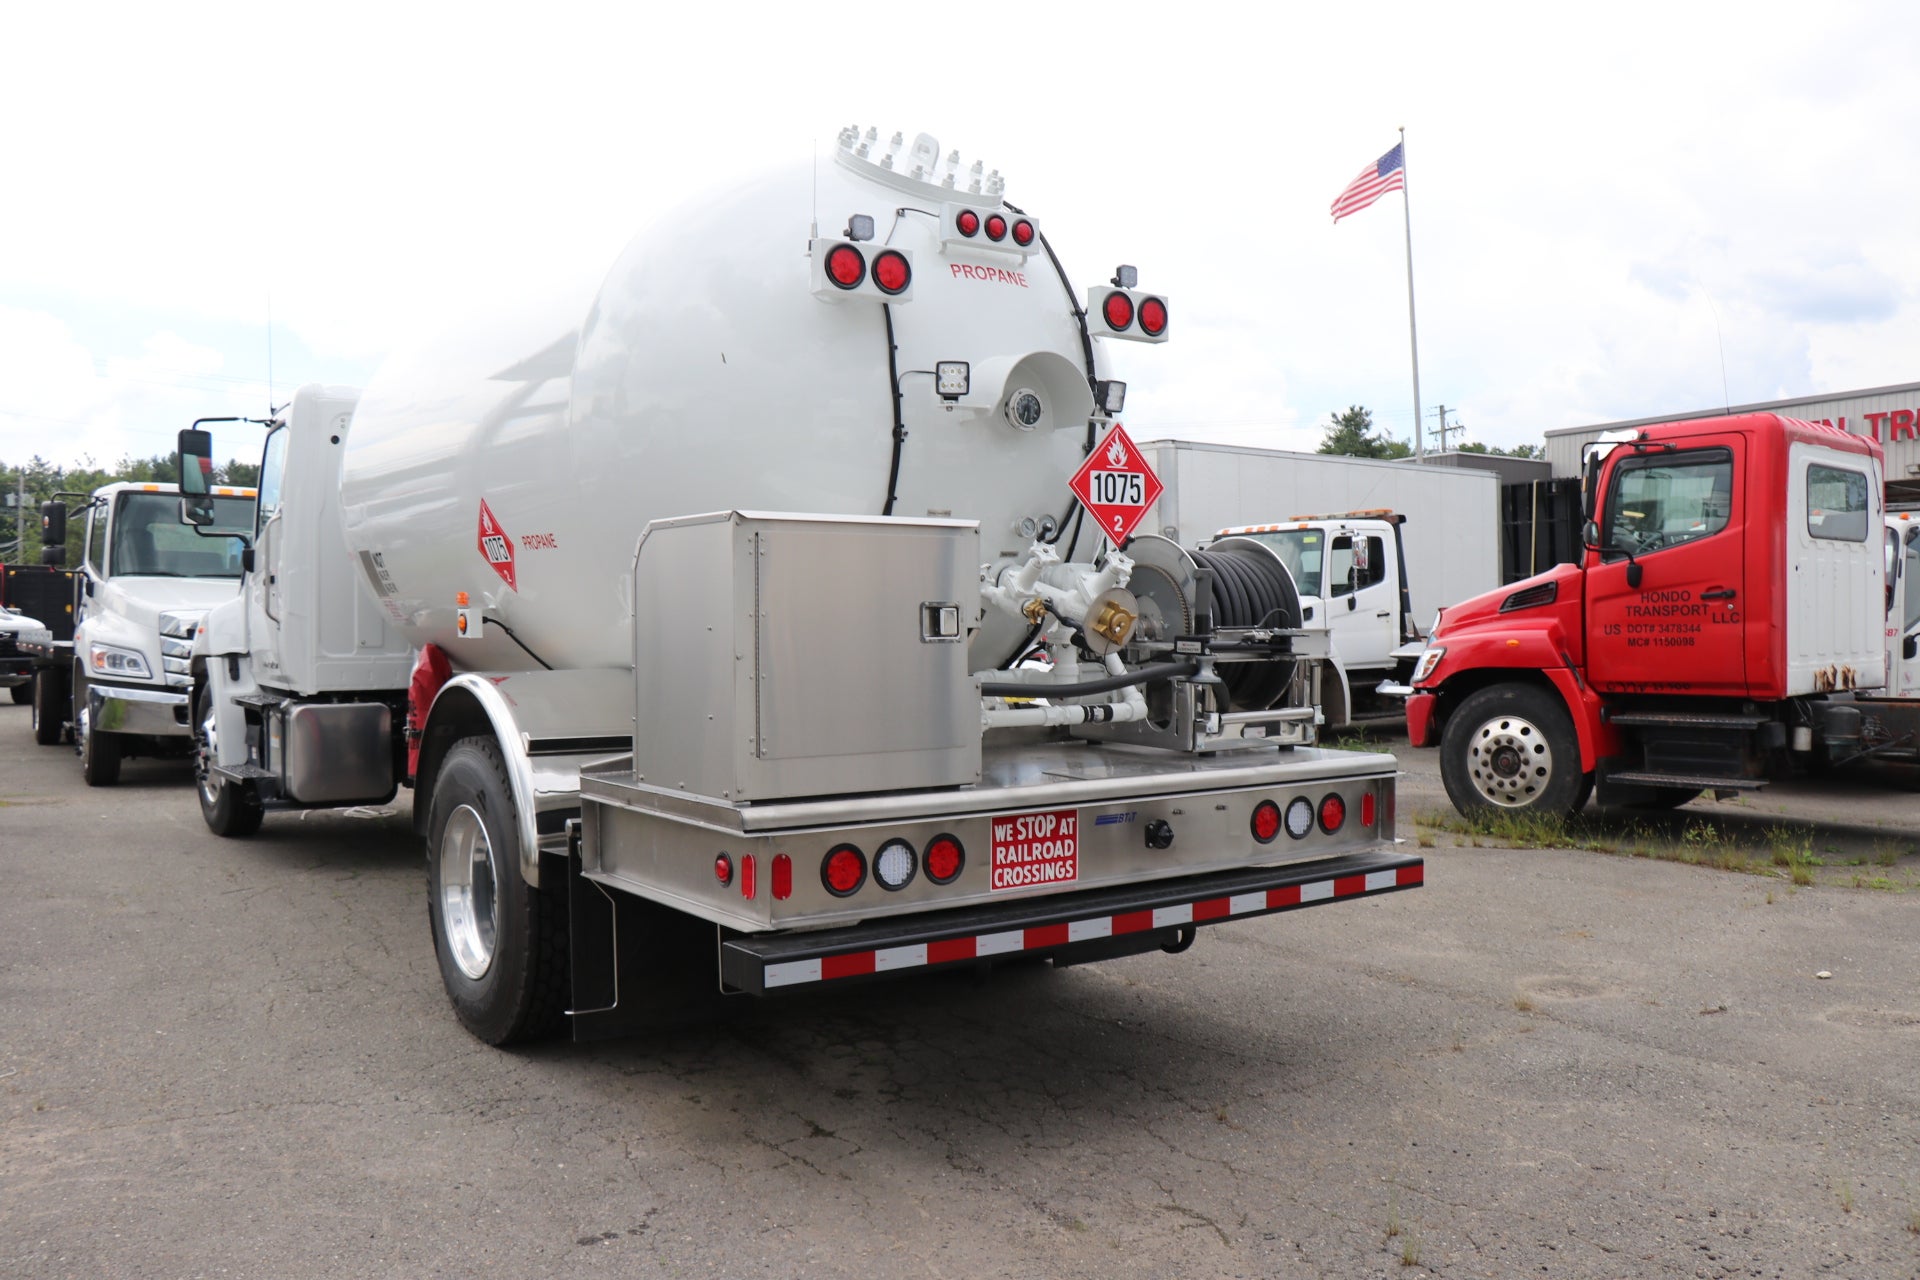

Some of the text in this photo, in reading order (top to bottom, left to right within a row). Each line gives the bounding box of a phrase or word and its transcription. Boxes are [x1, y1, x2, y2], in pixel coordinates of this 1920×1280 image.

[950, 264, 1029, 288] PROPANE
[1863, 408, 1920, 444] TR
[1094, 473, 1141, 504] 1075
[1113, 515, 1124, 532] 2
[484, 537, 509, 561] 1075
[522, 533, 558, 550] PROPANE
[503, 569, 512, 582] 2
[1641, 590, 1691, 603] HONDO
[1625, 604, 1740, 624] TRANSPORT LLC
[1604, 624, 1621, 635] US
[1627, 624, 1655, 633] DOT#
[1627, 638, 1650, 647] MC#
[994, 815, 1076, 843] WE STOP AT
[996, 839, 1075, 865] RAILROAD
[994, 860, 1074, 887] CROSSINGS
